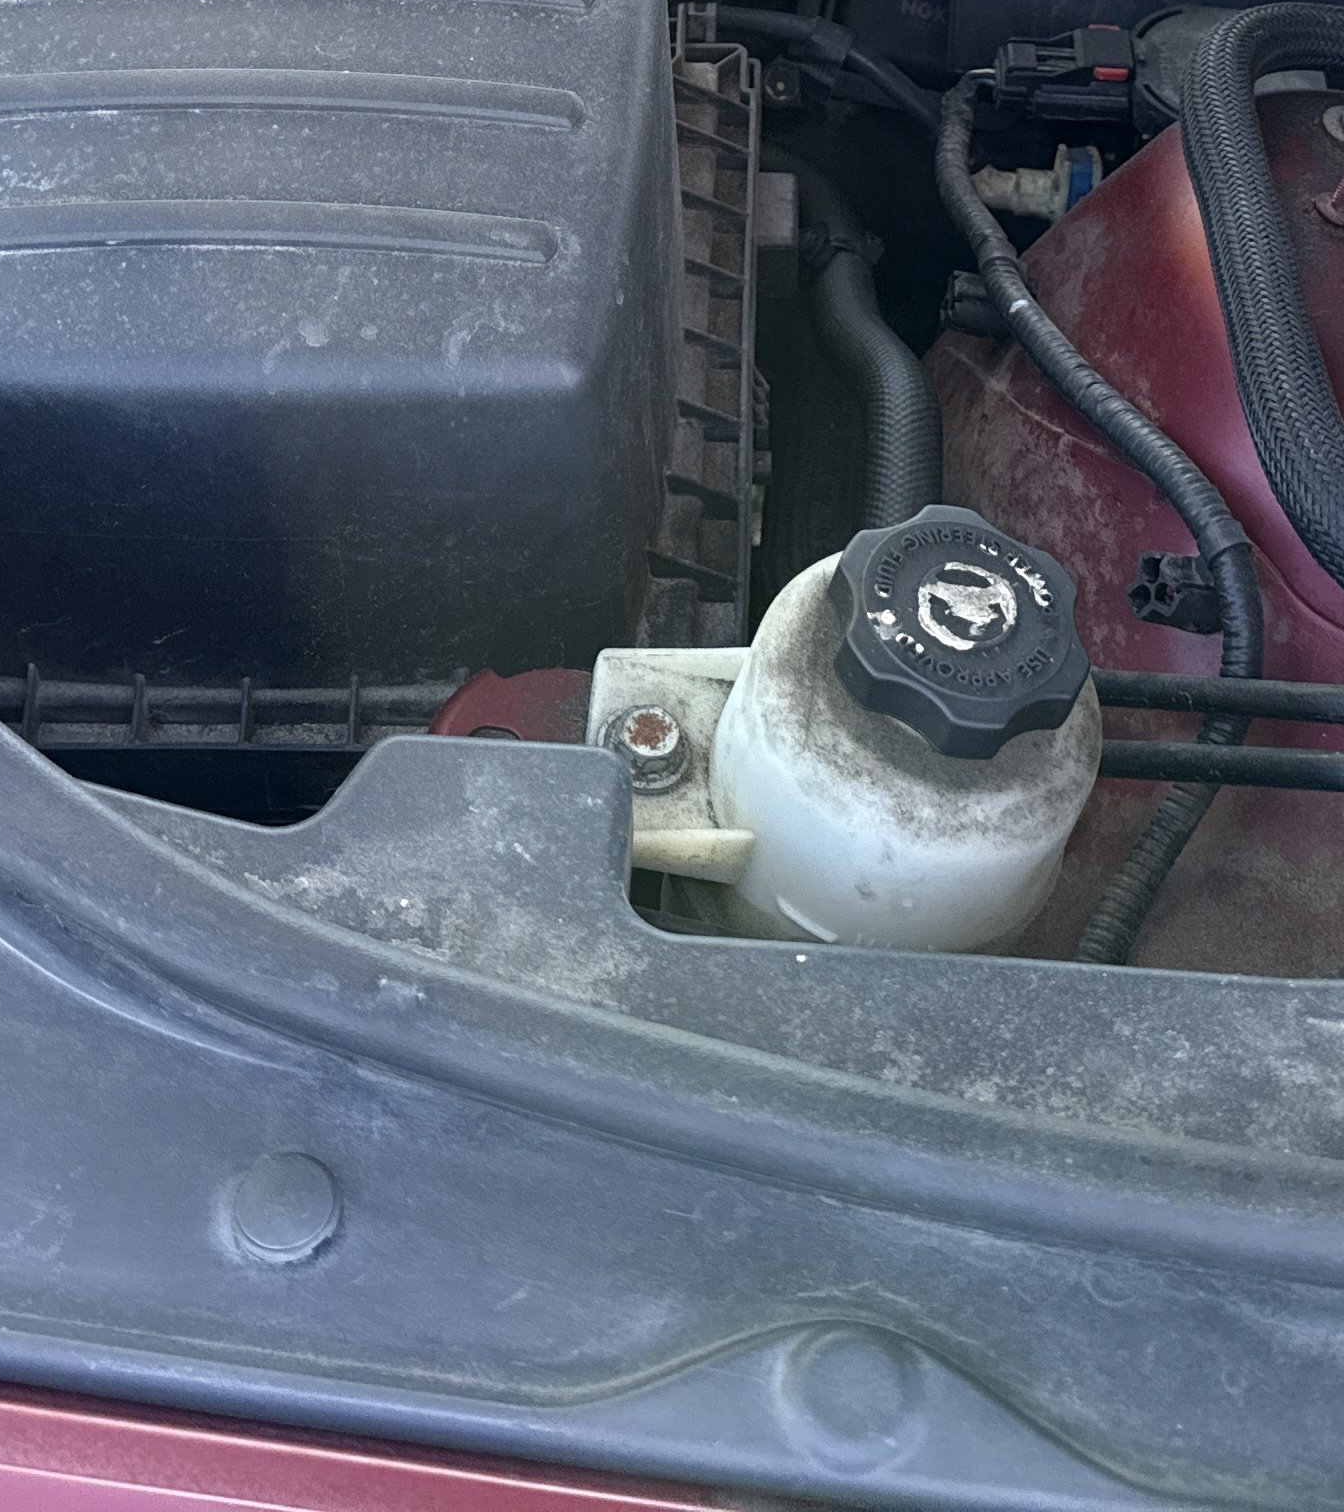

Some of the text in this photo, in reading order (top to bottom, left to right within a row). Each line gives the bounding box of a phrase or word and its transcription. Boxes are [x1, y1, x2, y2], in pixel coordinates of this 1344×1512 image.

[901, 528, 1002, 557] STEERING
[874, 549, 904, 599] FLUID
[1017, 646, 1054, 678] USE
